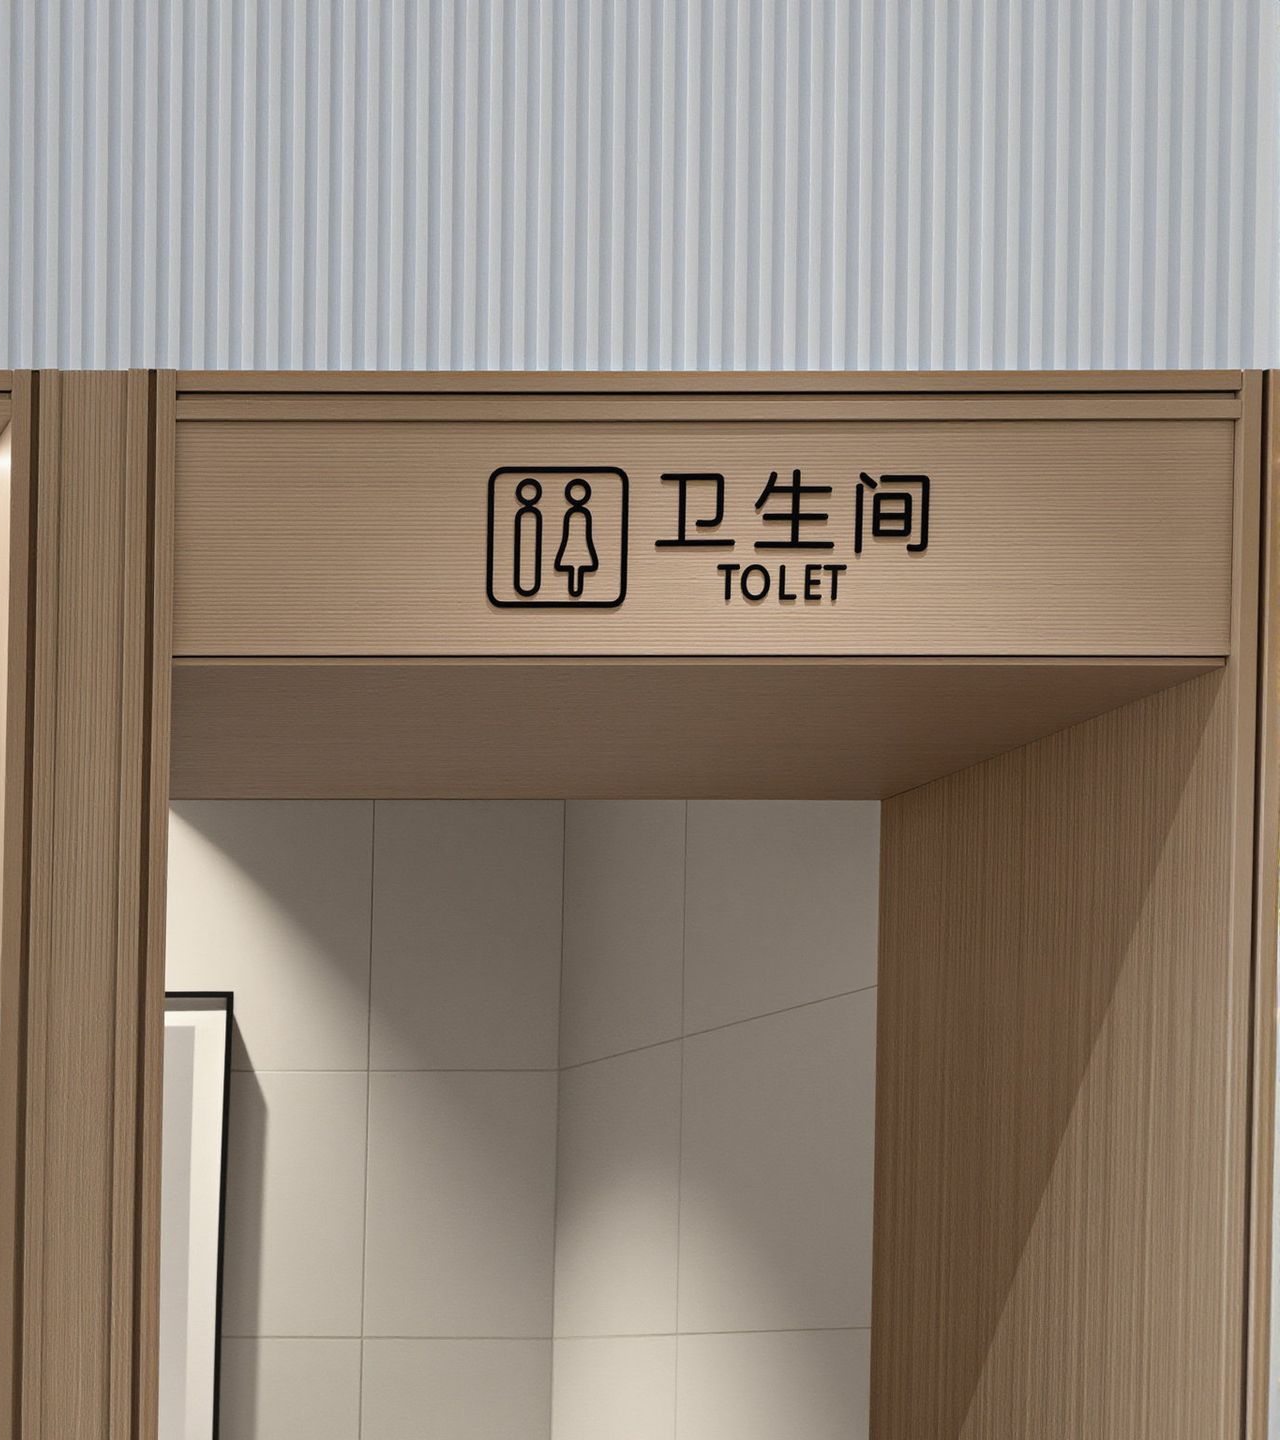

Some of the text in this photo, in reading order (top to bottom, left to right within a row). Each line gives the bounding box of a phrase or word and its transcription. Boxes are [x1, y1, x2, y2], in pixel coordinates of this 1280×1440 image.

[655, 469, 931, 554] 卫生间
[717, 563, 848, 601] TOLET
